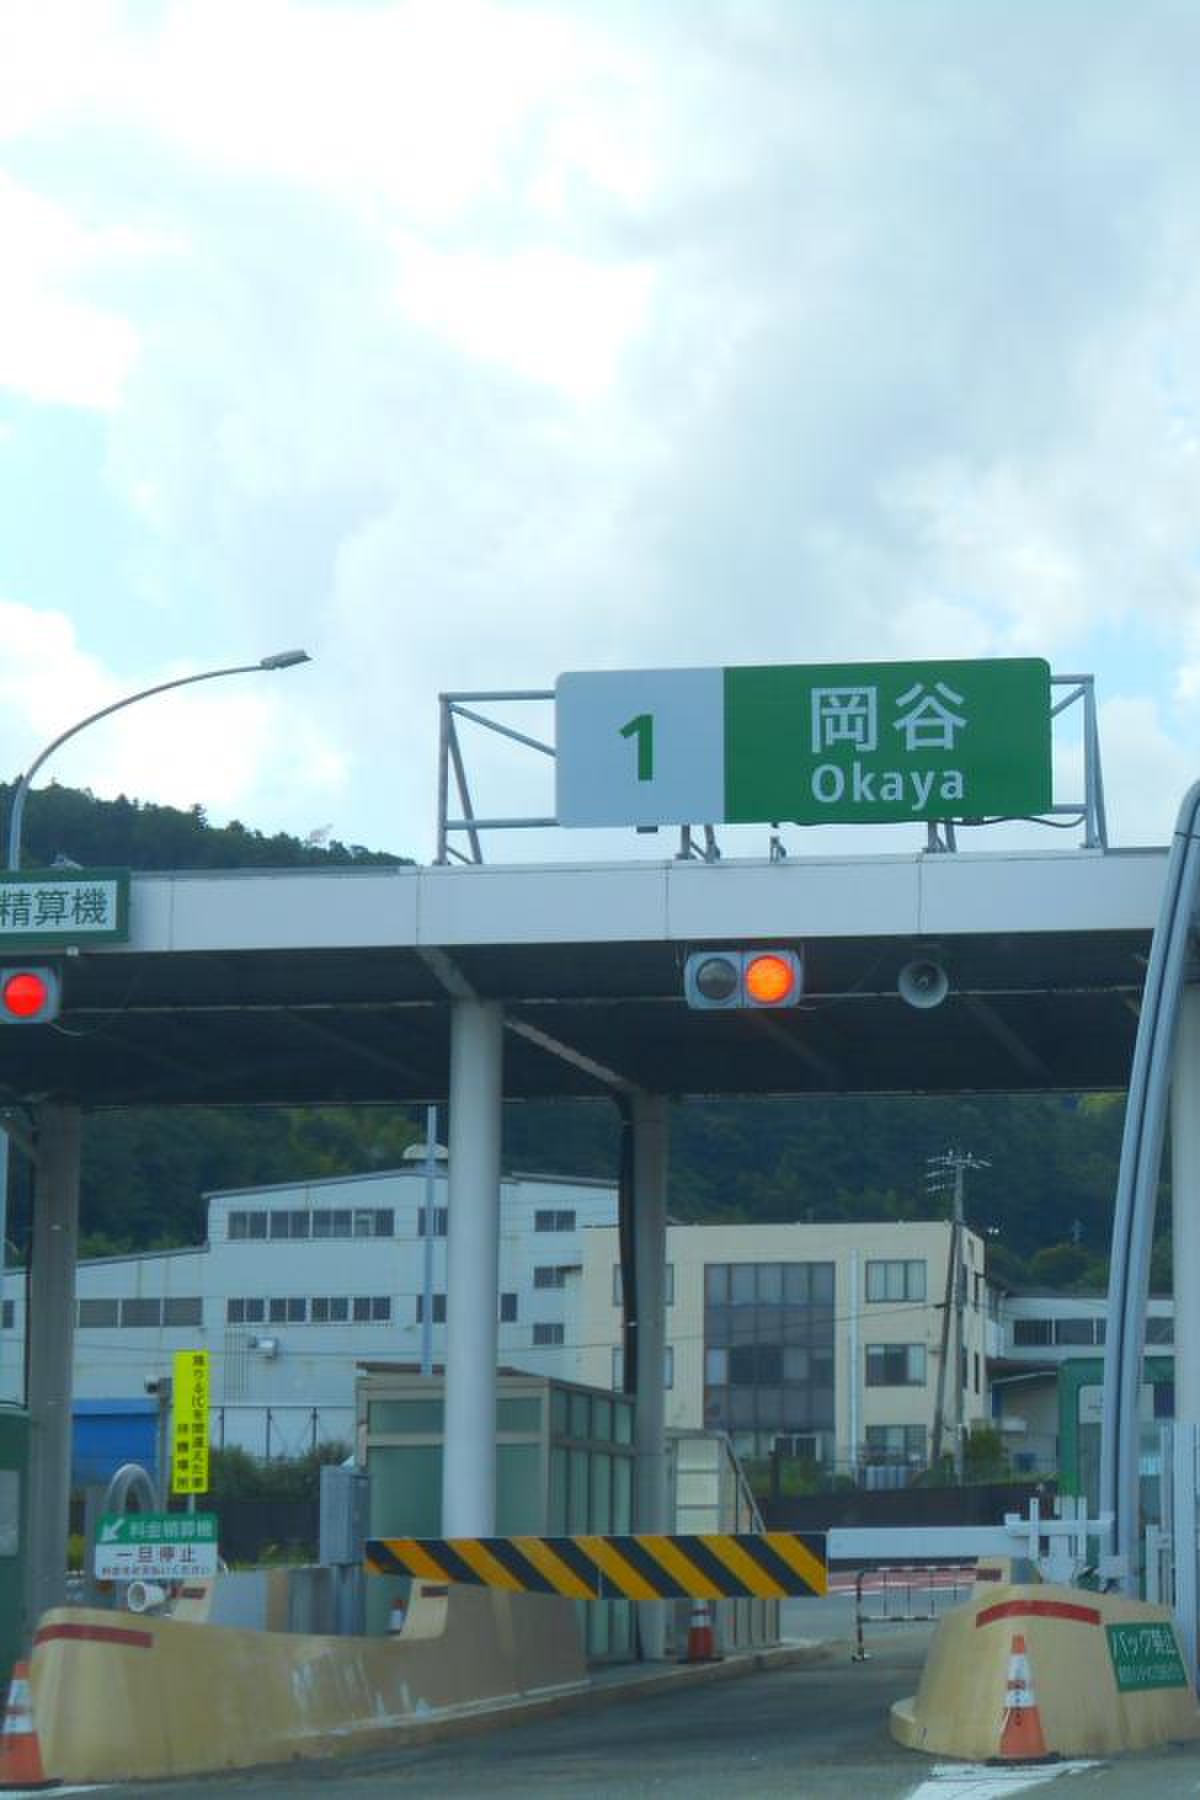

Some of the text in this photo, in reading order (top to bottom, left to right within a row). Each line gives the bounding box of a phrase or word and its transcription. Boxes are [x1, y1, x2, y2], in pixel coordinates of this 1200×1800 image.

[809, 681, 968, 753] 岡谷
[618, 713, 655, 783] 1
[810, 760, 966, 811] Okaya
[0, 887, 108, 927] 精算機
